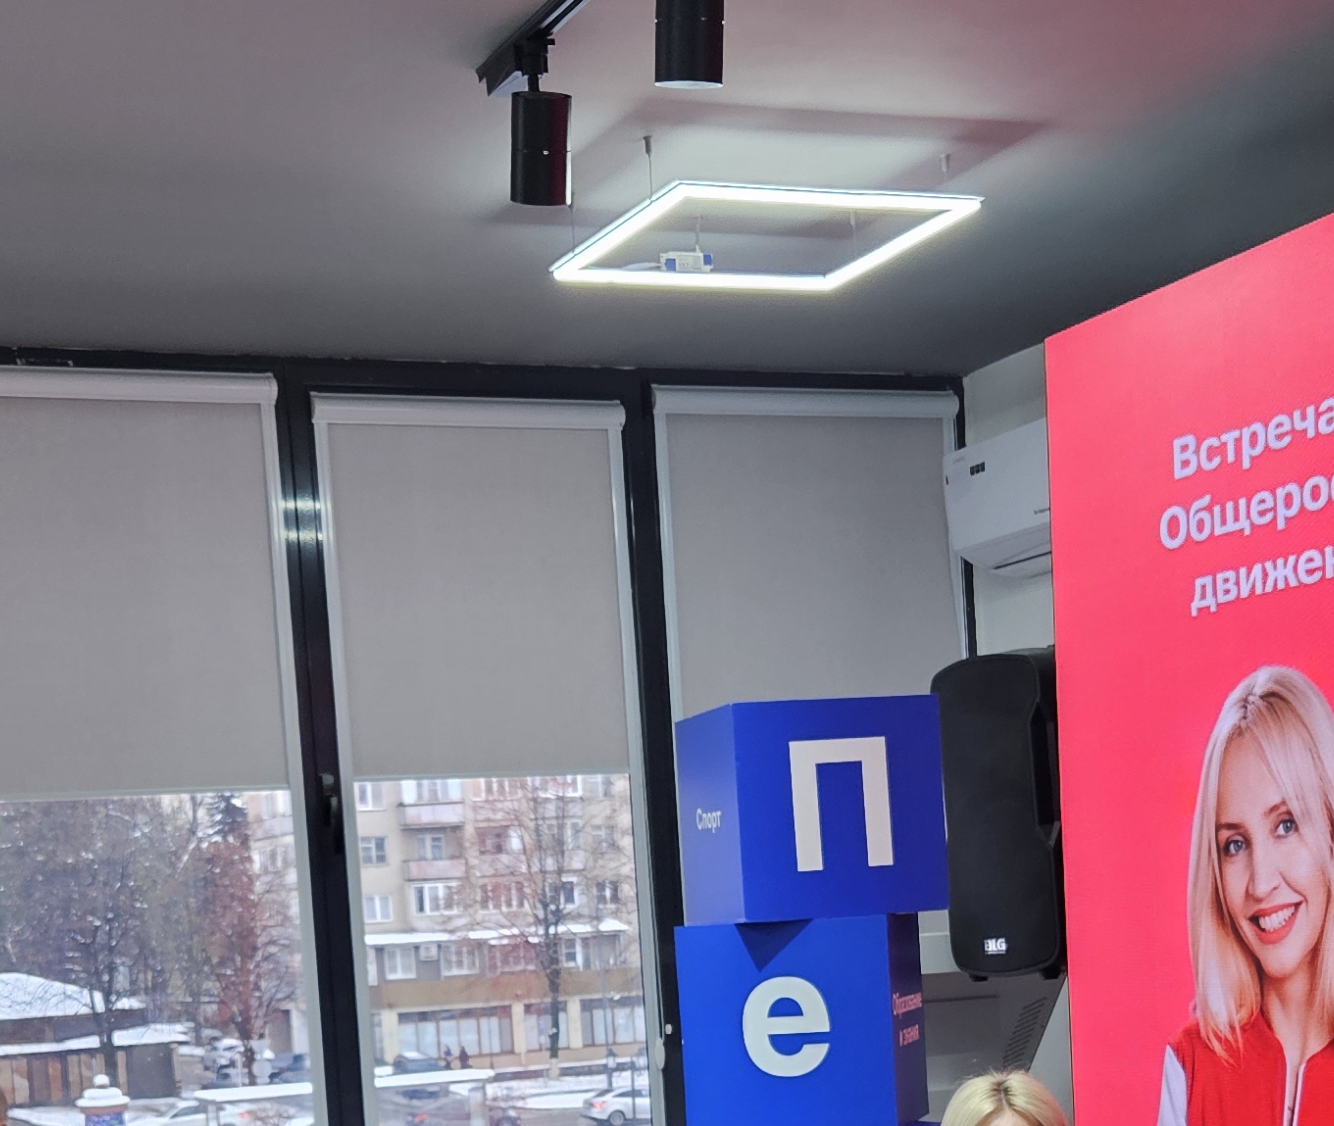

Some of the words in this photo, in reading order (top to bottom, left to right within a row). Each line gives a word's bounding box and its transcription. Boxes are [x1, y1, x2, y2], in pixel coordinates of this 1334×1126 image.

[696, 808, 722, 834] Спорт
[788, 736, 895, 872] П
[742, 976, 831, 1078] е
